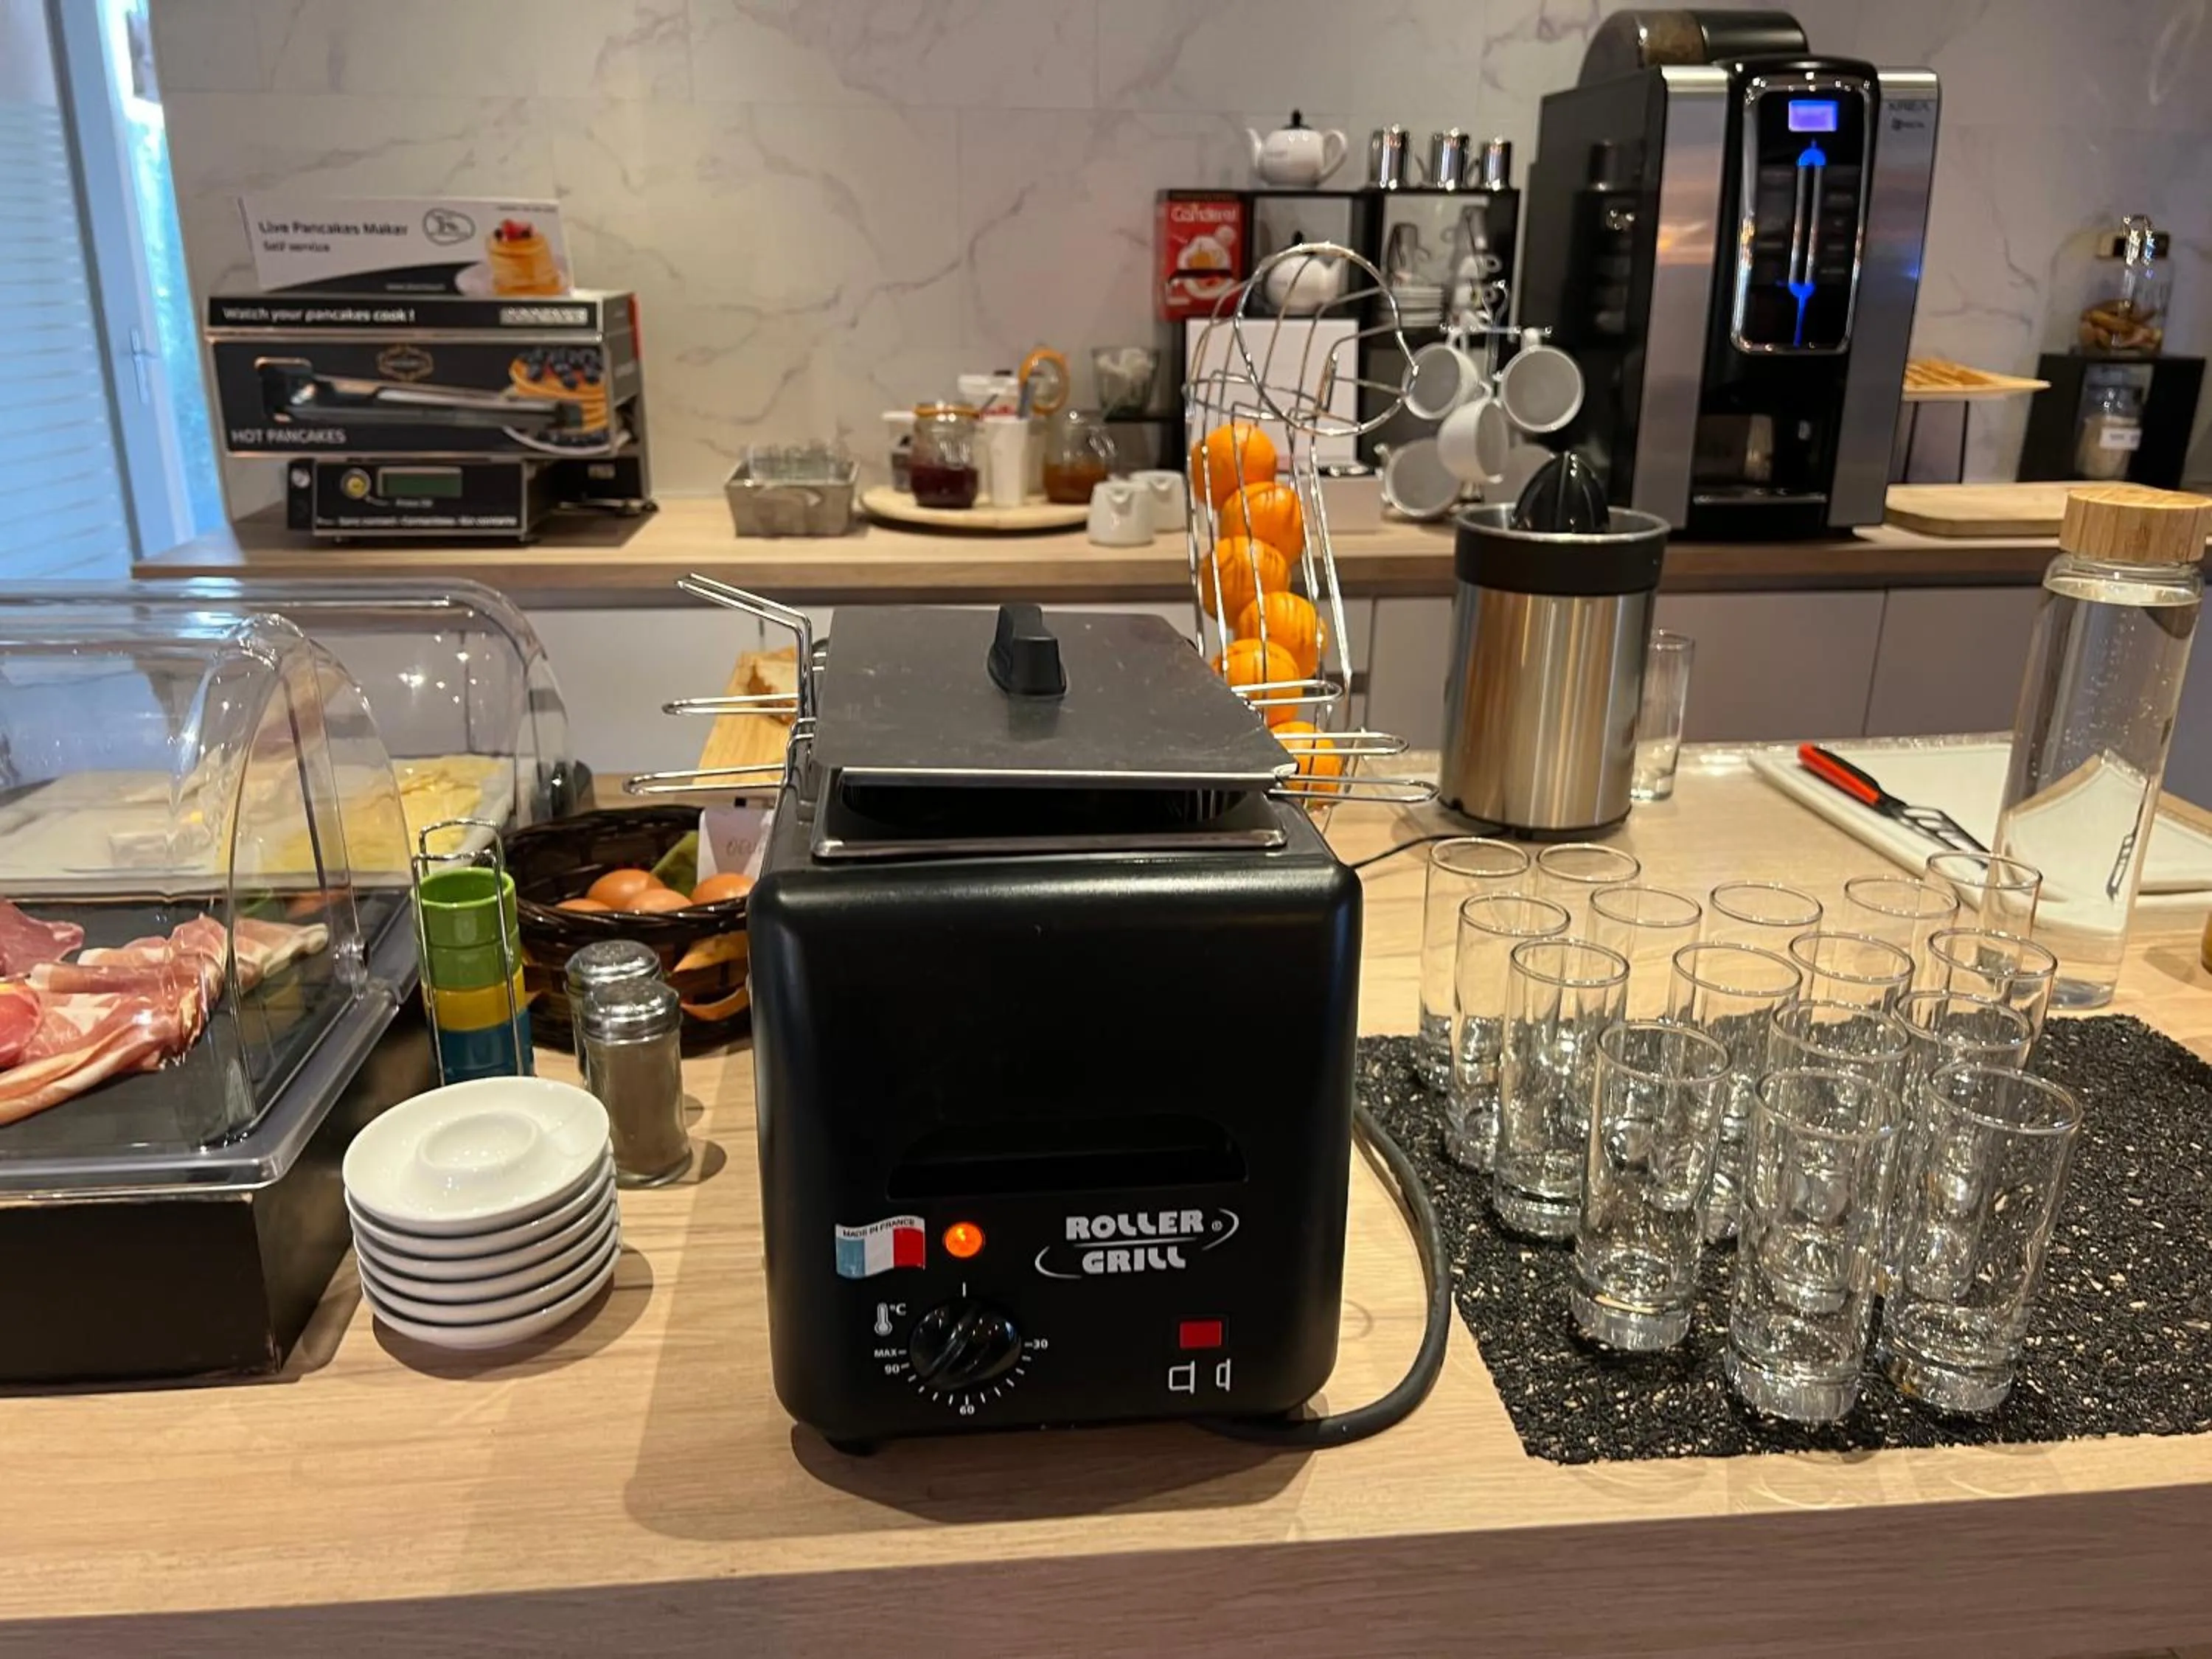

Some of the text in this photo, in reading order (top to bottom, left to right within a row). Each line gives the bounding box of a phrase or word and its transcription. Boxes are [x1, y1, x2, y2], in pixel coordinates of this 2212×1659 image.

[258, 220, 408, 235] Live Pancakes Maker
[223, 307, 269, 320] Watch
[270, 308, 303, 323] your
[305, 307, 370, 323] pancakes
[372, 307, 406, 322] cook
[231, 428, 347, 444] HOT PANCAKES
[843, 1217, 915, 1237] MADE IN FRANCE
[1065, 1209, 1204, 1240] ROLLER
[1082, 1245, 1186, 1275] GRILL
[1033, 1338, 1048, 1350] 30
[874, 1347, 897, 1357] MAX
[885, 1363, 900, 1375] 90
[959, 1404, 975, 1416] 60
